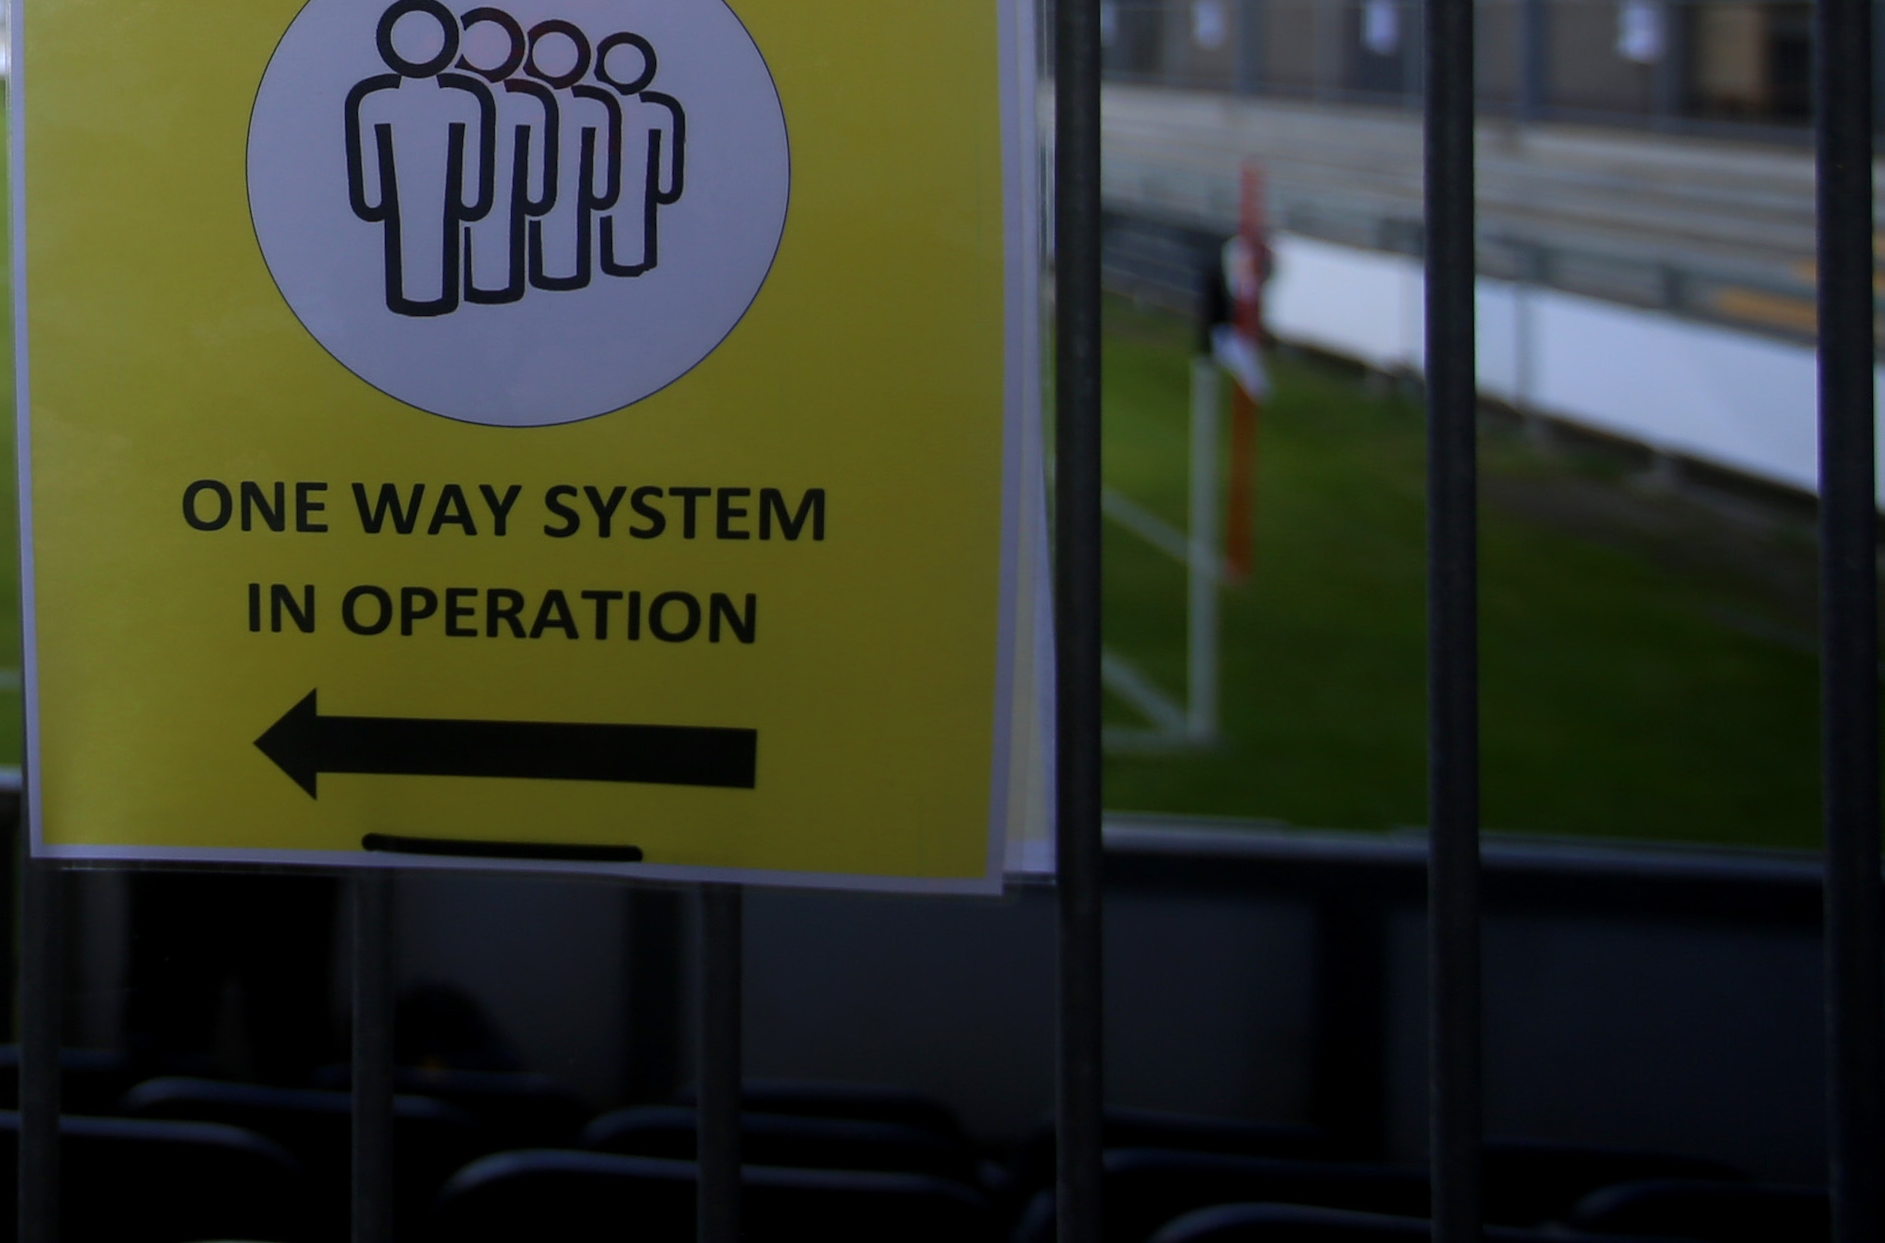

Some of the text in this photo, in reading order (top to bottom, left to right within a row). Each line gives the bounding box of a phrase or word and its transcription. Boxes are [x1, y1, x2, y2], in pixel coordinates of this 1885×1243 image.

[181, 478, 826, 542] ONE WAY SYSTEM
[247, 582, 758, 644] IN OPERATION
